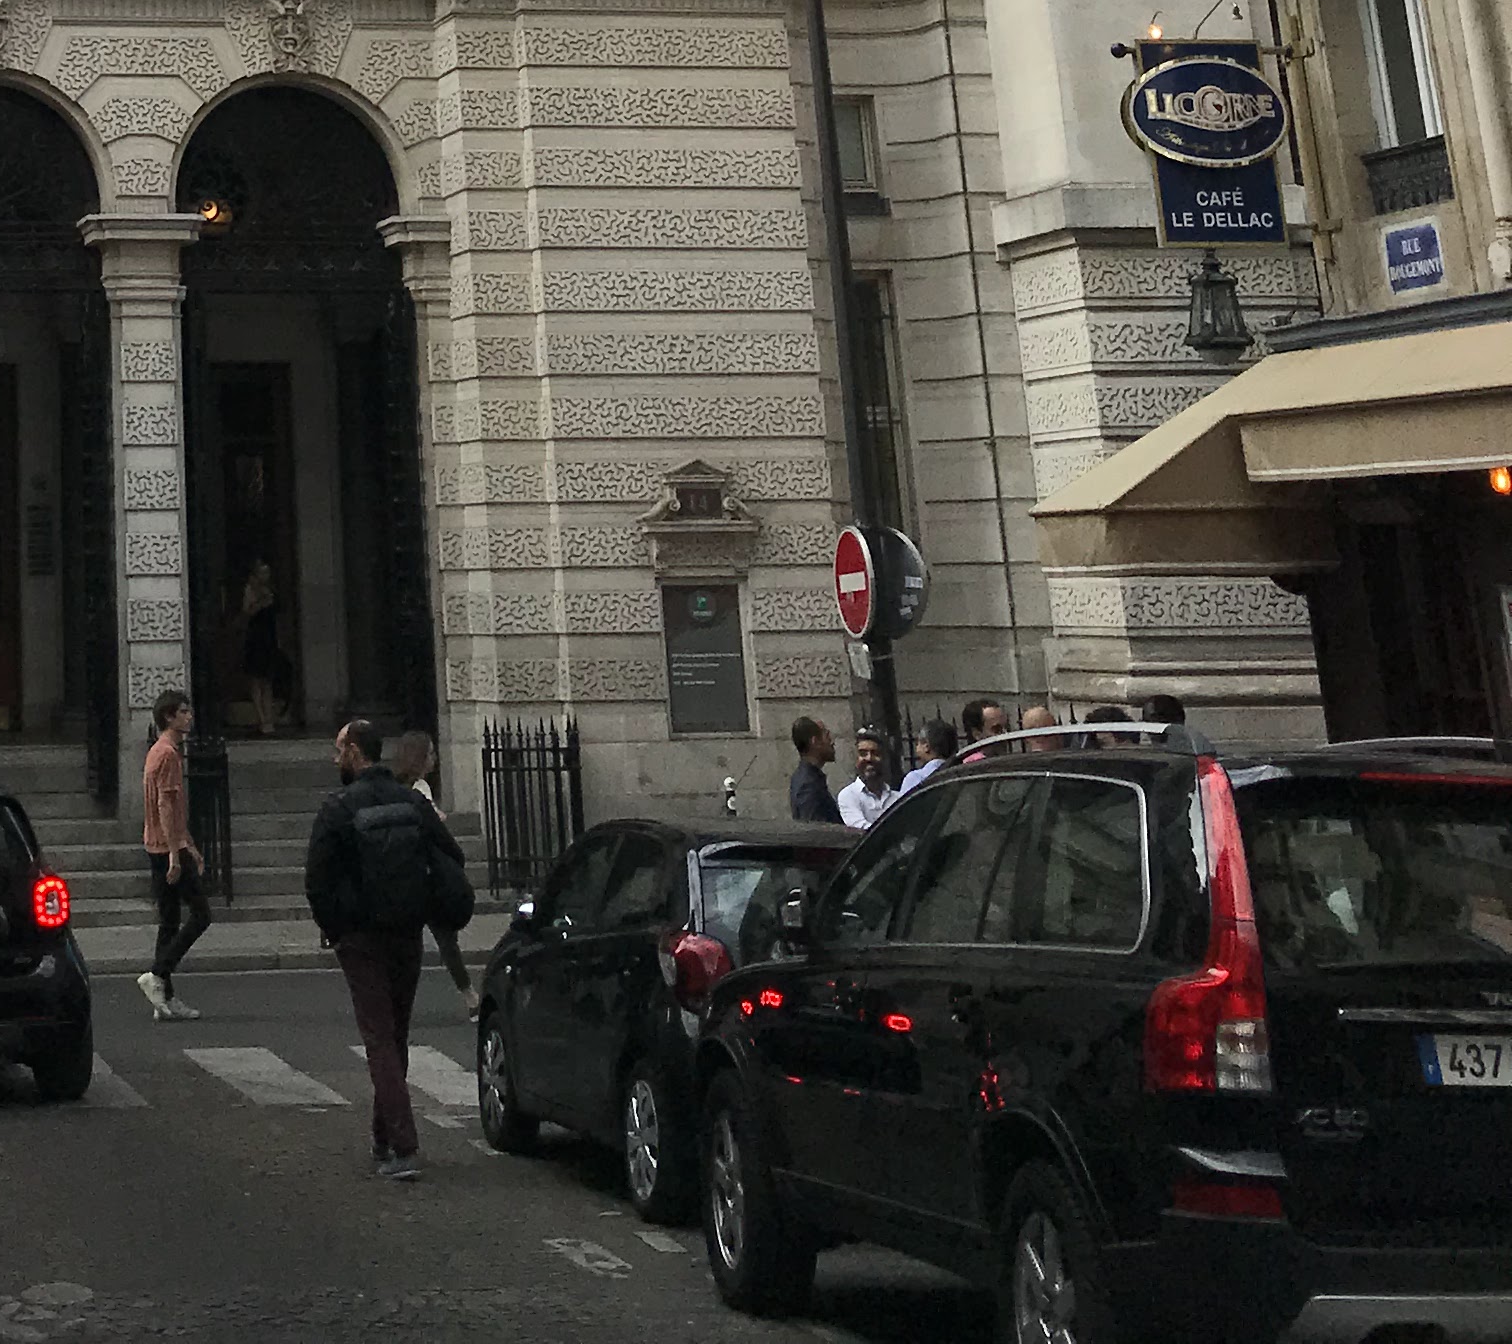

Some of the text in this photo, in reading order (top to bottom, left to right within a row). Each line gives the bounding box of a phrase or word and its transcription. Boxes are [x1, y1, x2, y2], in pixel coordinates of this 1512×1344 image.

[1196, 186, 1244, 206] CAFÉ
[1172, 212, 1274, 228] LE DELLAC
